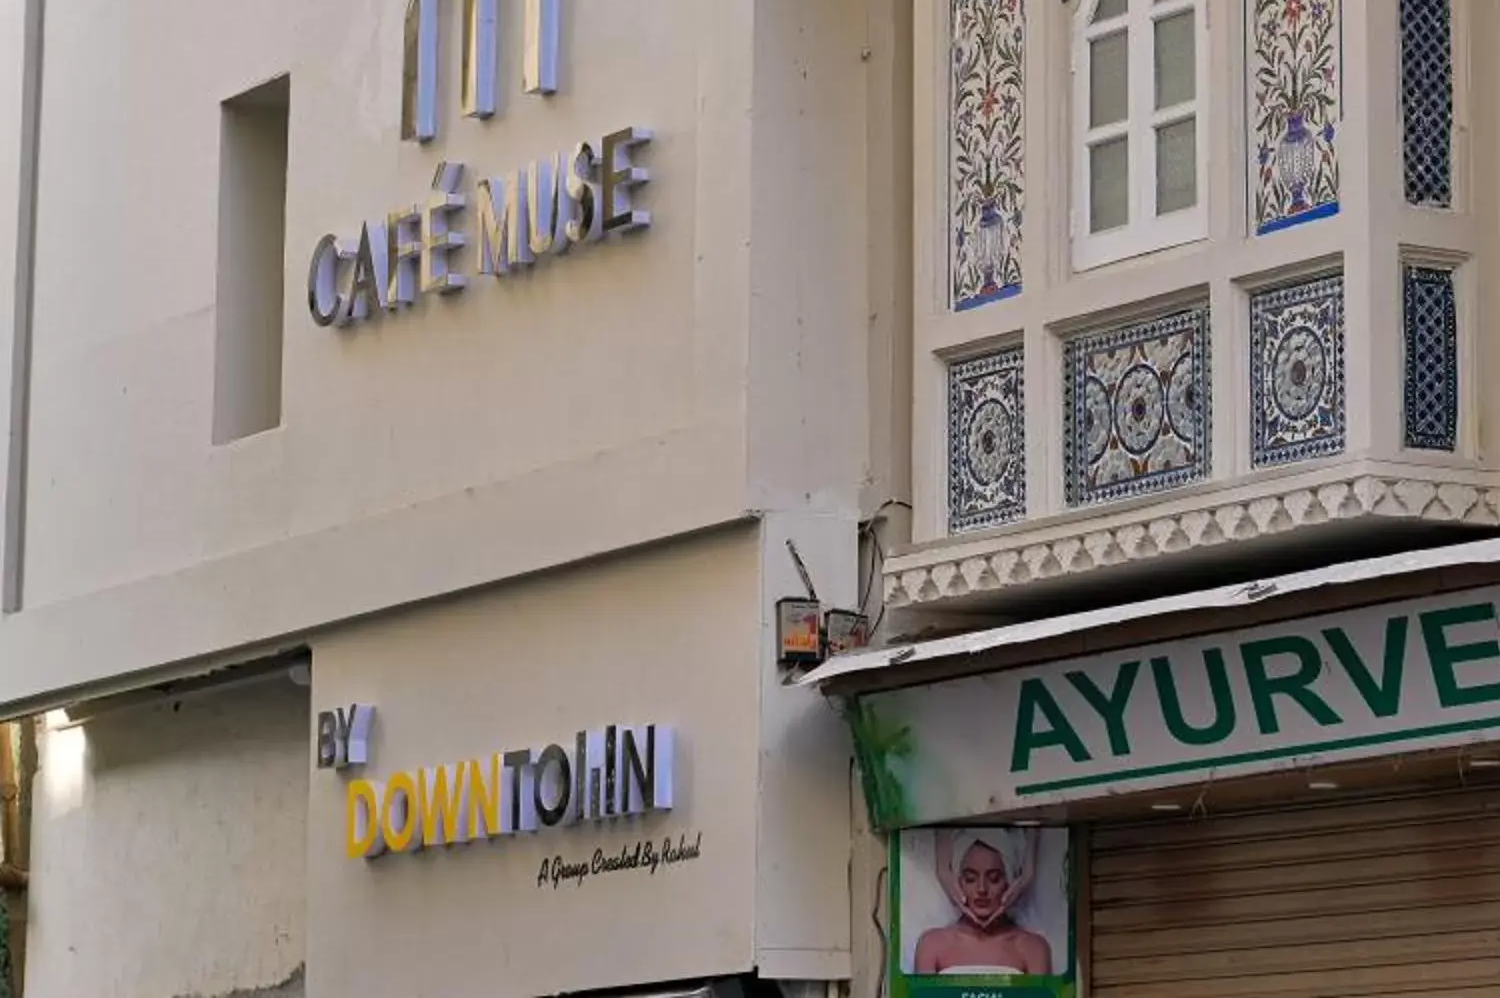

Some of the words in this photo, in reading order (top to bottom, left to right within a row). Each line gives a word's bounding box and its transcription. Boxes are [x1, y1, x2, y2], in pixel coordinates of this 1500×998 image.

[308, 161, 467, 328] CAFÉ
[477, 126, 654, 276] MUSE
[317, 703, 377, 769] BY
[538, 858, 549, 887] A
[551, 855, 590, 890] Group
[591, 841, 641, 875] Created
[642, 840, 661, 875] By
[661, 831, 703, 866] Rahul
